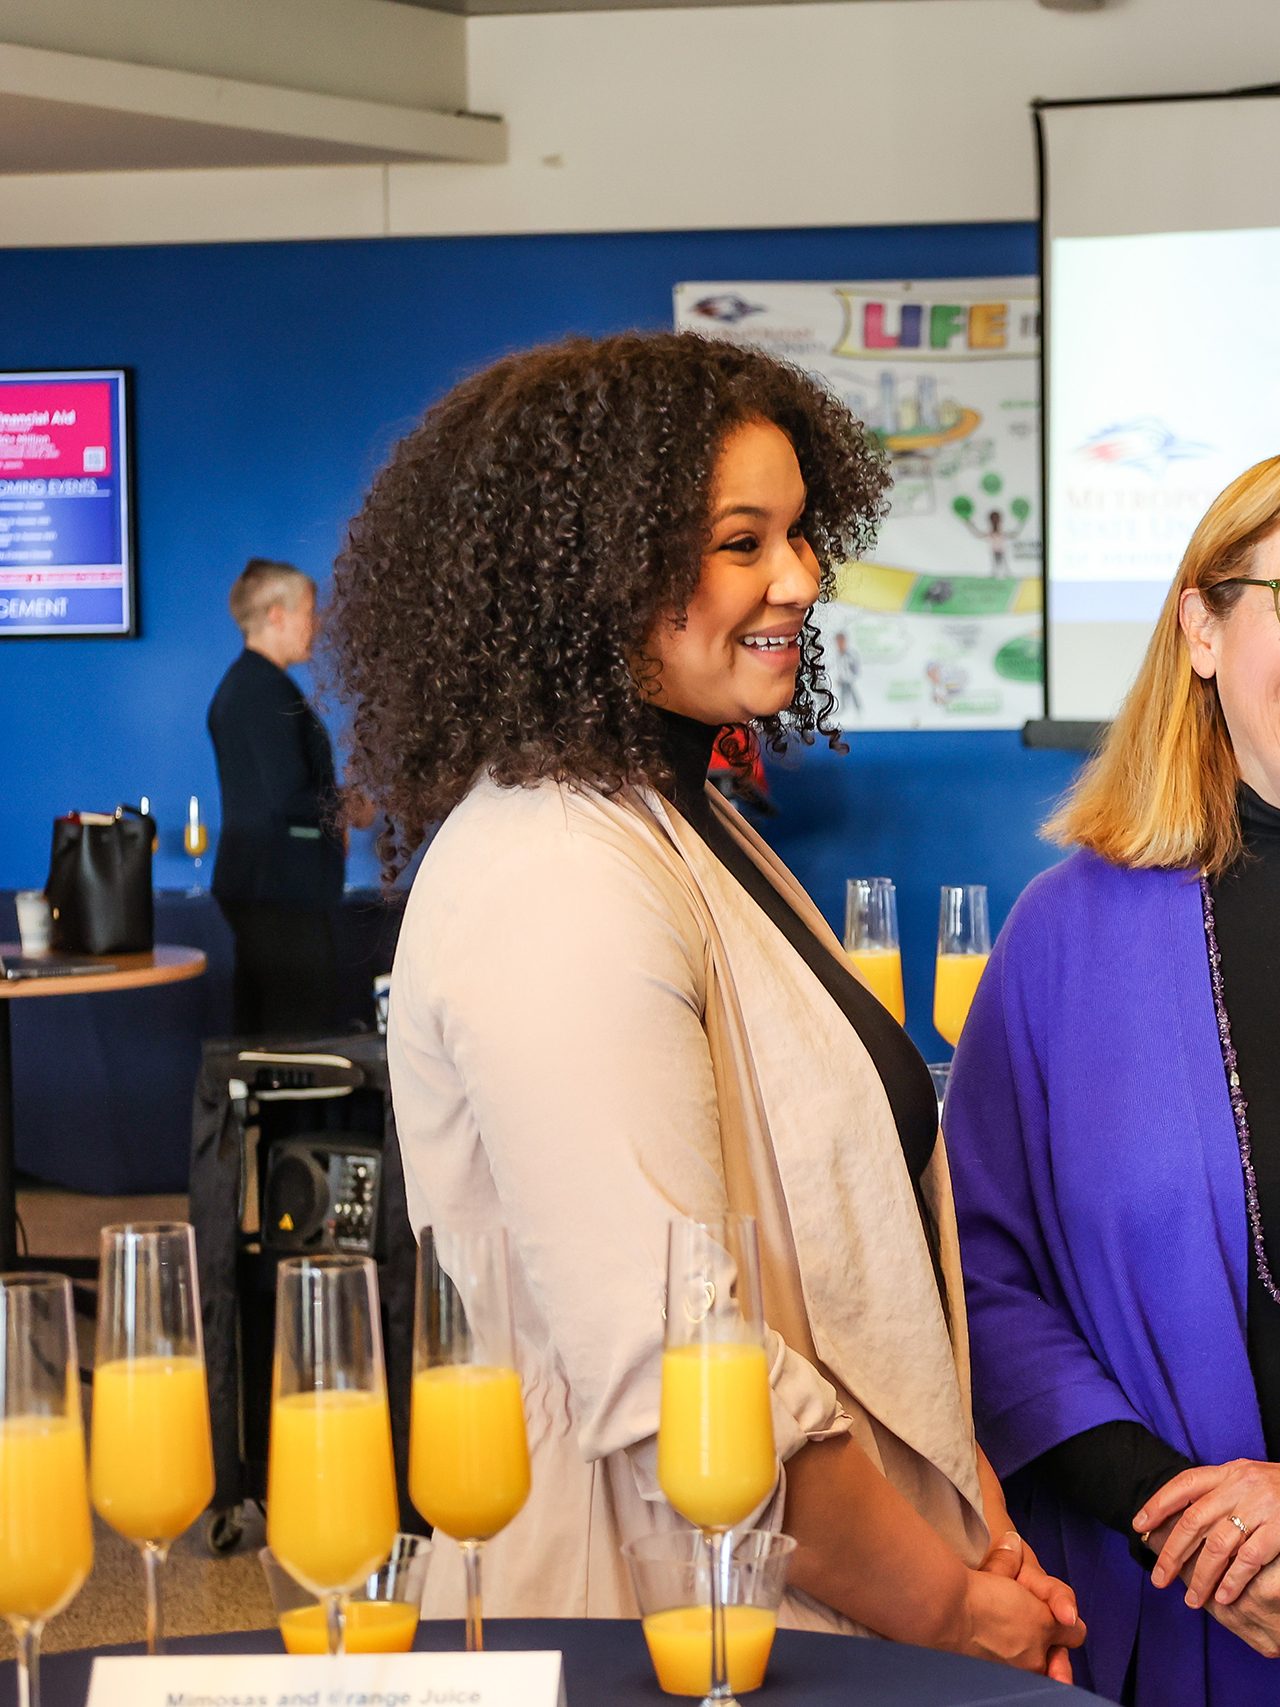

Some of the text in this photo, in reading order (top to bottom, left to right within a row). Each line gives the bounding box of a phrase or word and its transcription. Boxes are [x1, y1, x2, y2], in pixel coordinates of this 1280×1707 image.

[864, 303, 1008, 349] LIFE
[51, 409, 76, 427] Aid
[277, 1690, 320, 1706] and
[420, 1688, 480, 1705] Juice
